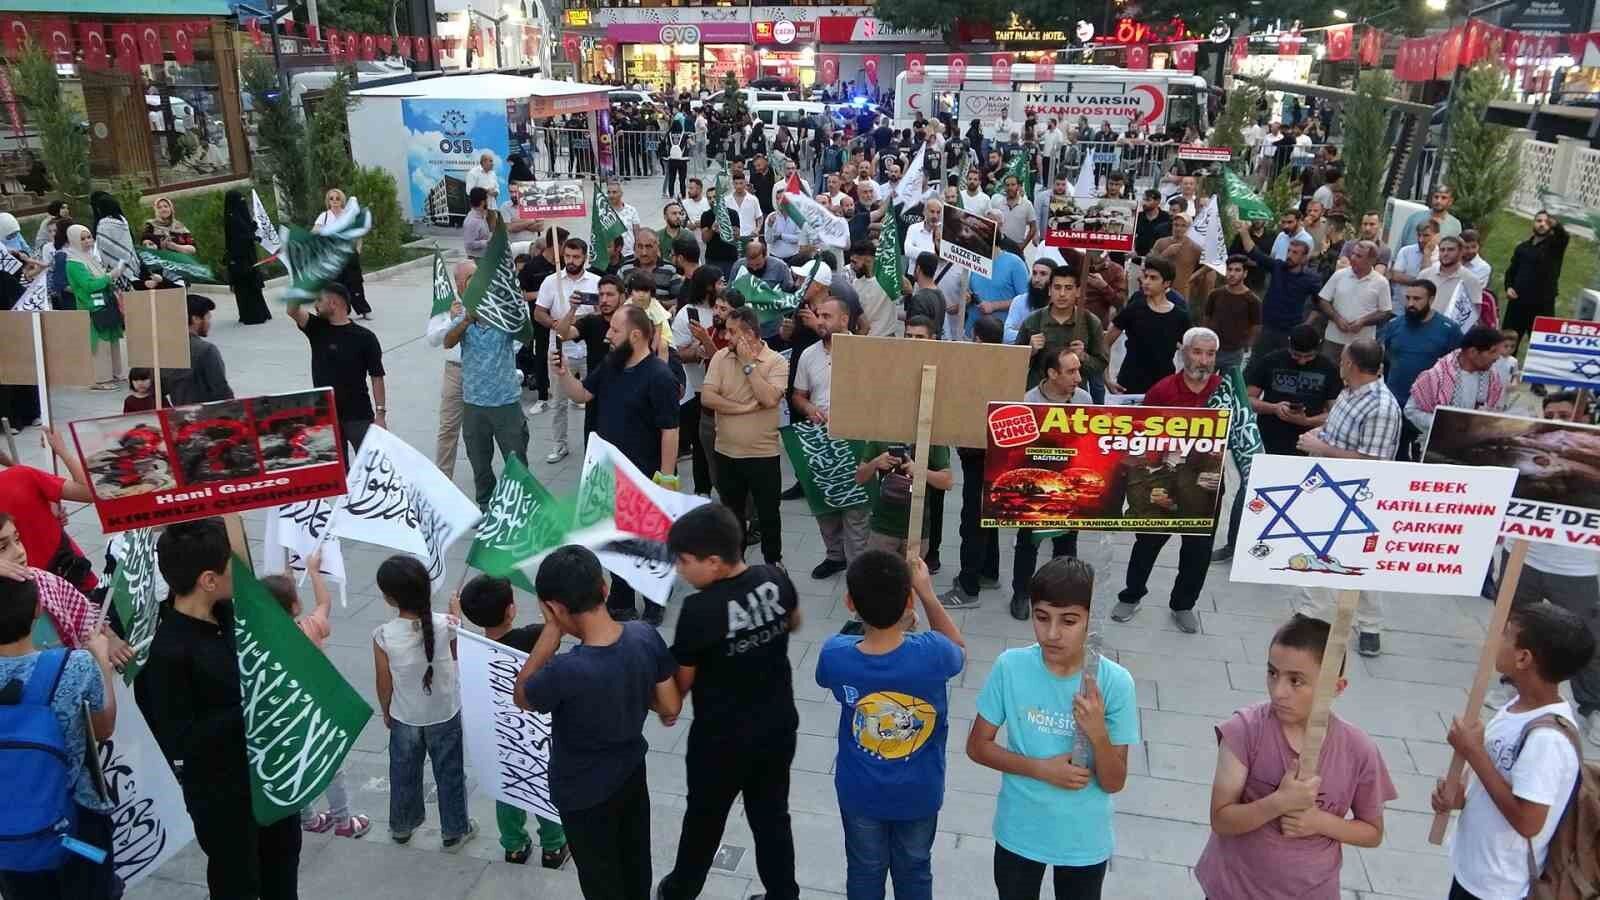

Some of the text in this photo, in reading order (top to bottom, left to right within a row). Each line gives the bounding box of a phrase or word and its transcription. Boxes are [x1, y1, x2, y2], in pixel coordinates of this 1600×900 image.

[661, 26, 699, 43] eve
[1042, 31, 1067, 40] HOTEL
[1077, 95, 1140, 105] VARSIN
[1544, 334, 1599, 348] BOYK
[992, 414, 1034, 430] BURGER
[1144, 410, 1230, 438] seni
[994, 423, 1037, 440] KING
[156, 477, 290, 505] Hani Gazze
[1409, 480, 1468, 494] BEBEK
[1385, 540, 1460, 555] ÇEVİREN
[1376, 560, 1463, 575] SEN OLMA
[727, 581, 786, 639] AIR
